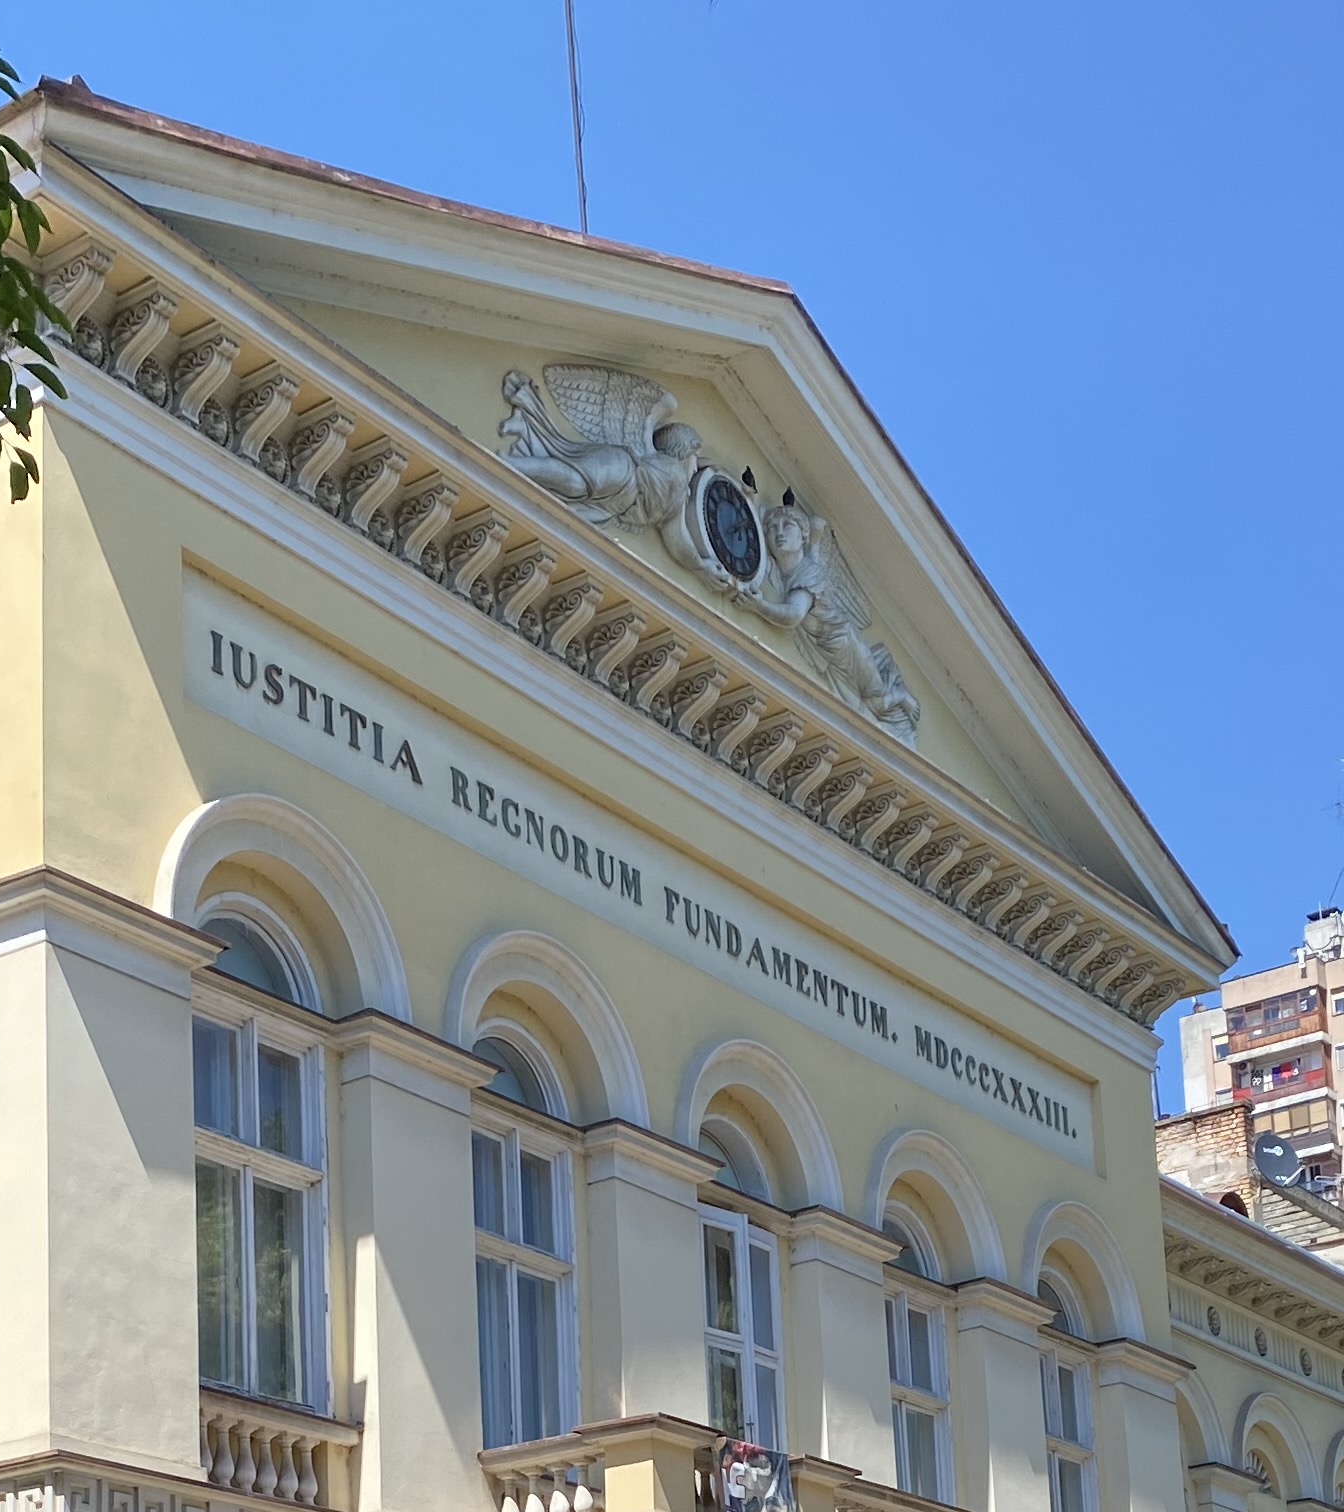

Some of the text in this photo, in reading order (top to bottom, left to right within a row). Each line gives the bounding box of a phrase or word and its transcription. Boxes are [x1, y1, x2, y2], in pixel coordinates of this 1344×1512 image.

[210, 630, 423, 785] IUSTITIA
[663, 886, 898, 1043] FUNDAMENTUM.
[914, 1025, 1078, 1139] MDCCCXXXIII.
